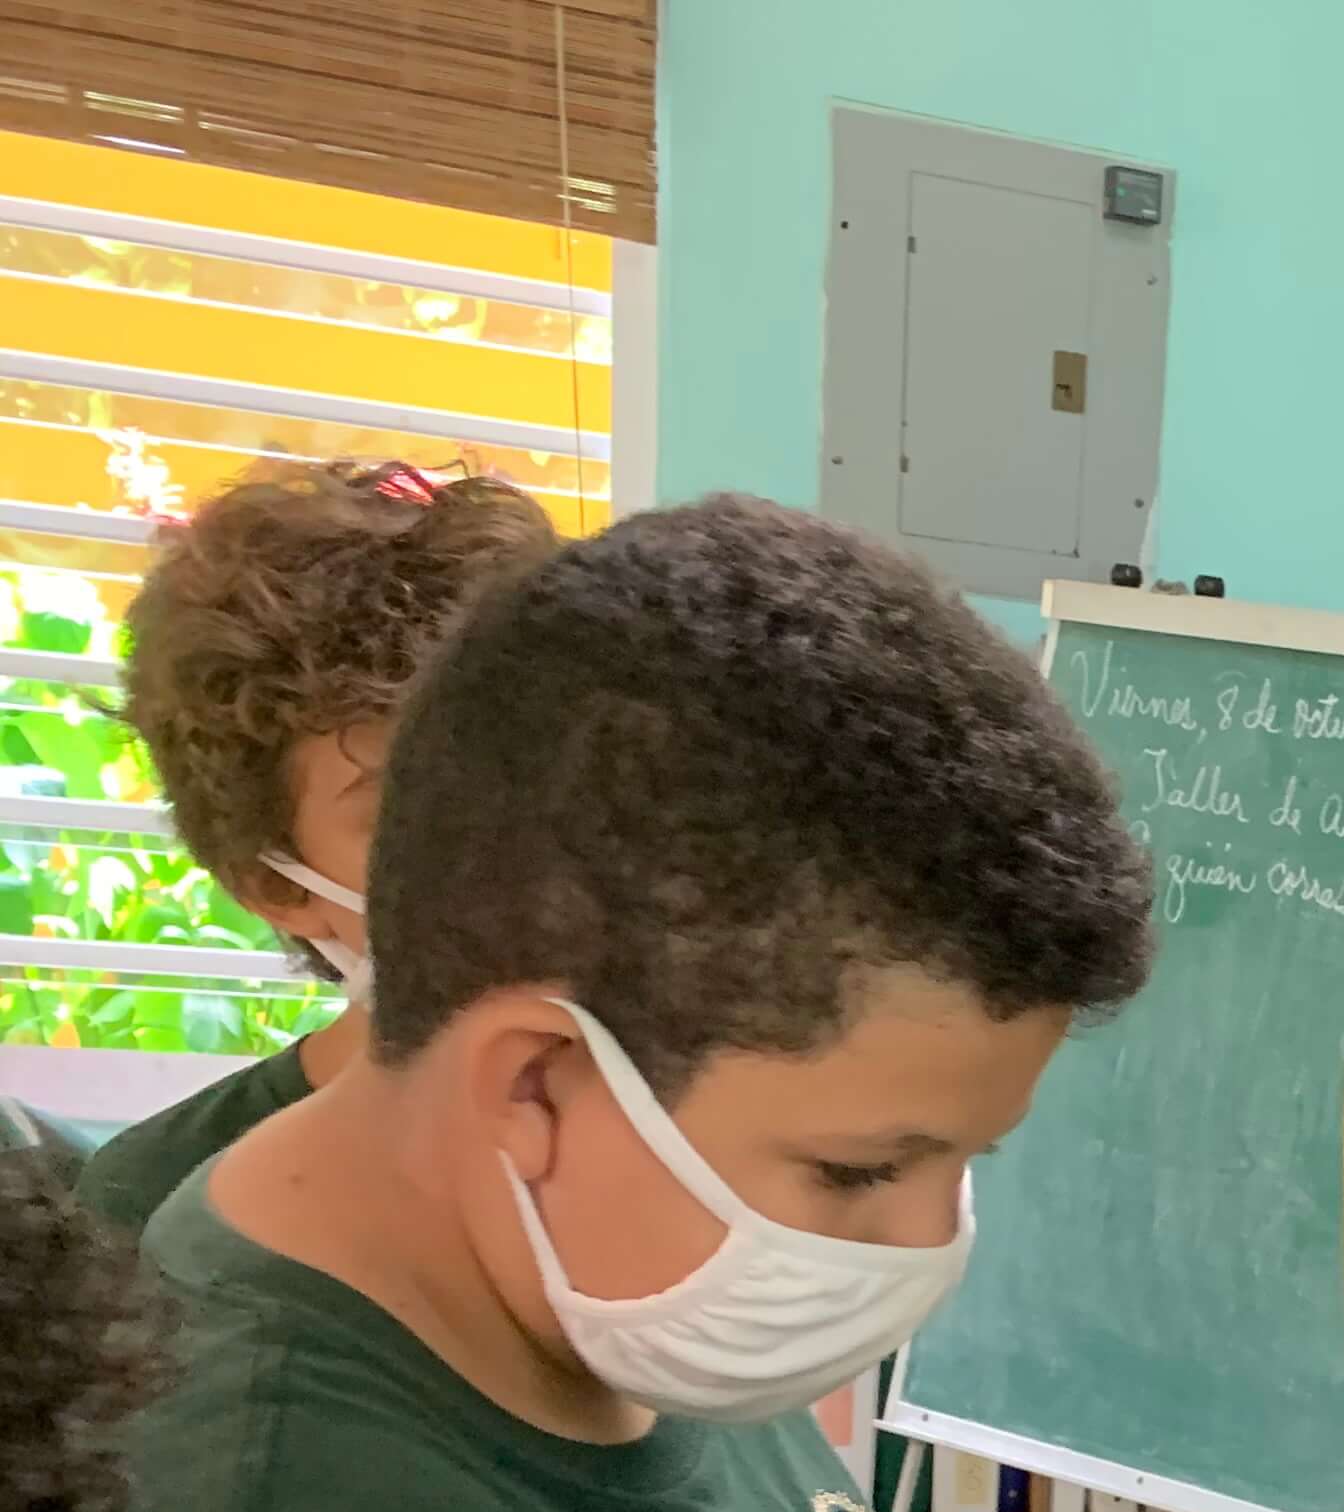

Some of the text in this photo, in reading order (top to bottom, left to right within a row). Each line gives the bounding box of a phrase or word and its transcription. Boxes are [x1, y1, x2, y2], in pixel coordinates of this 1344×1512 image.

[1217, 684, 1240, 731] 8
[1242, 677, 1282, 733] de
[1141, 747, 1250, 824] Taller
[1268, 775, 1302, 836] de
